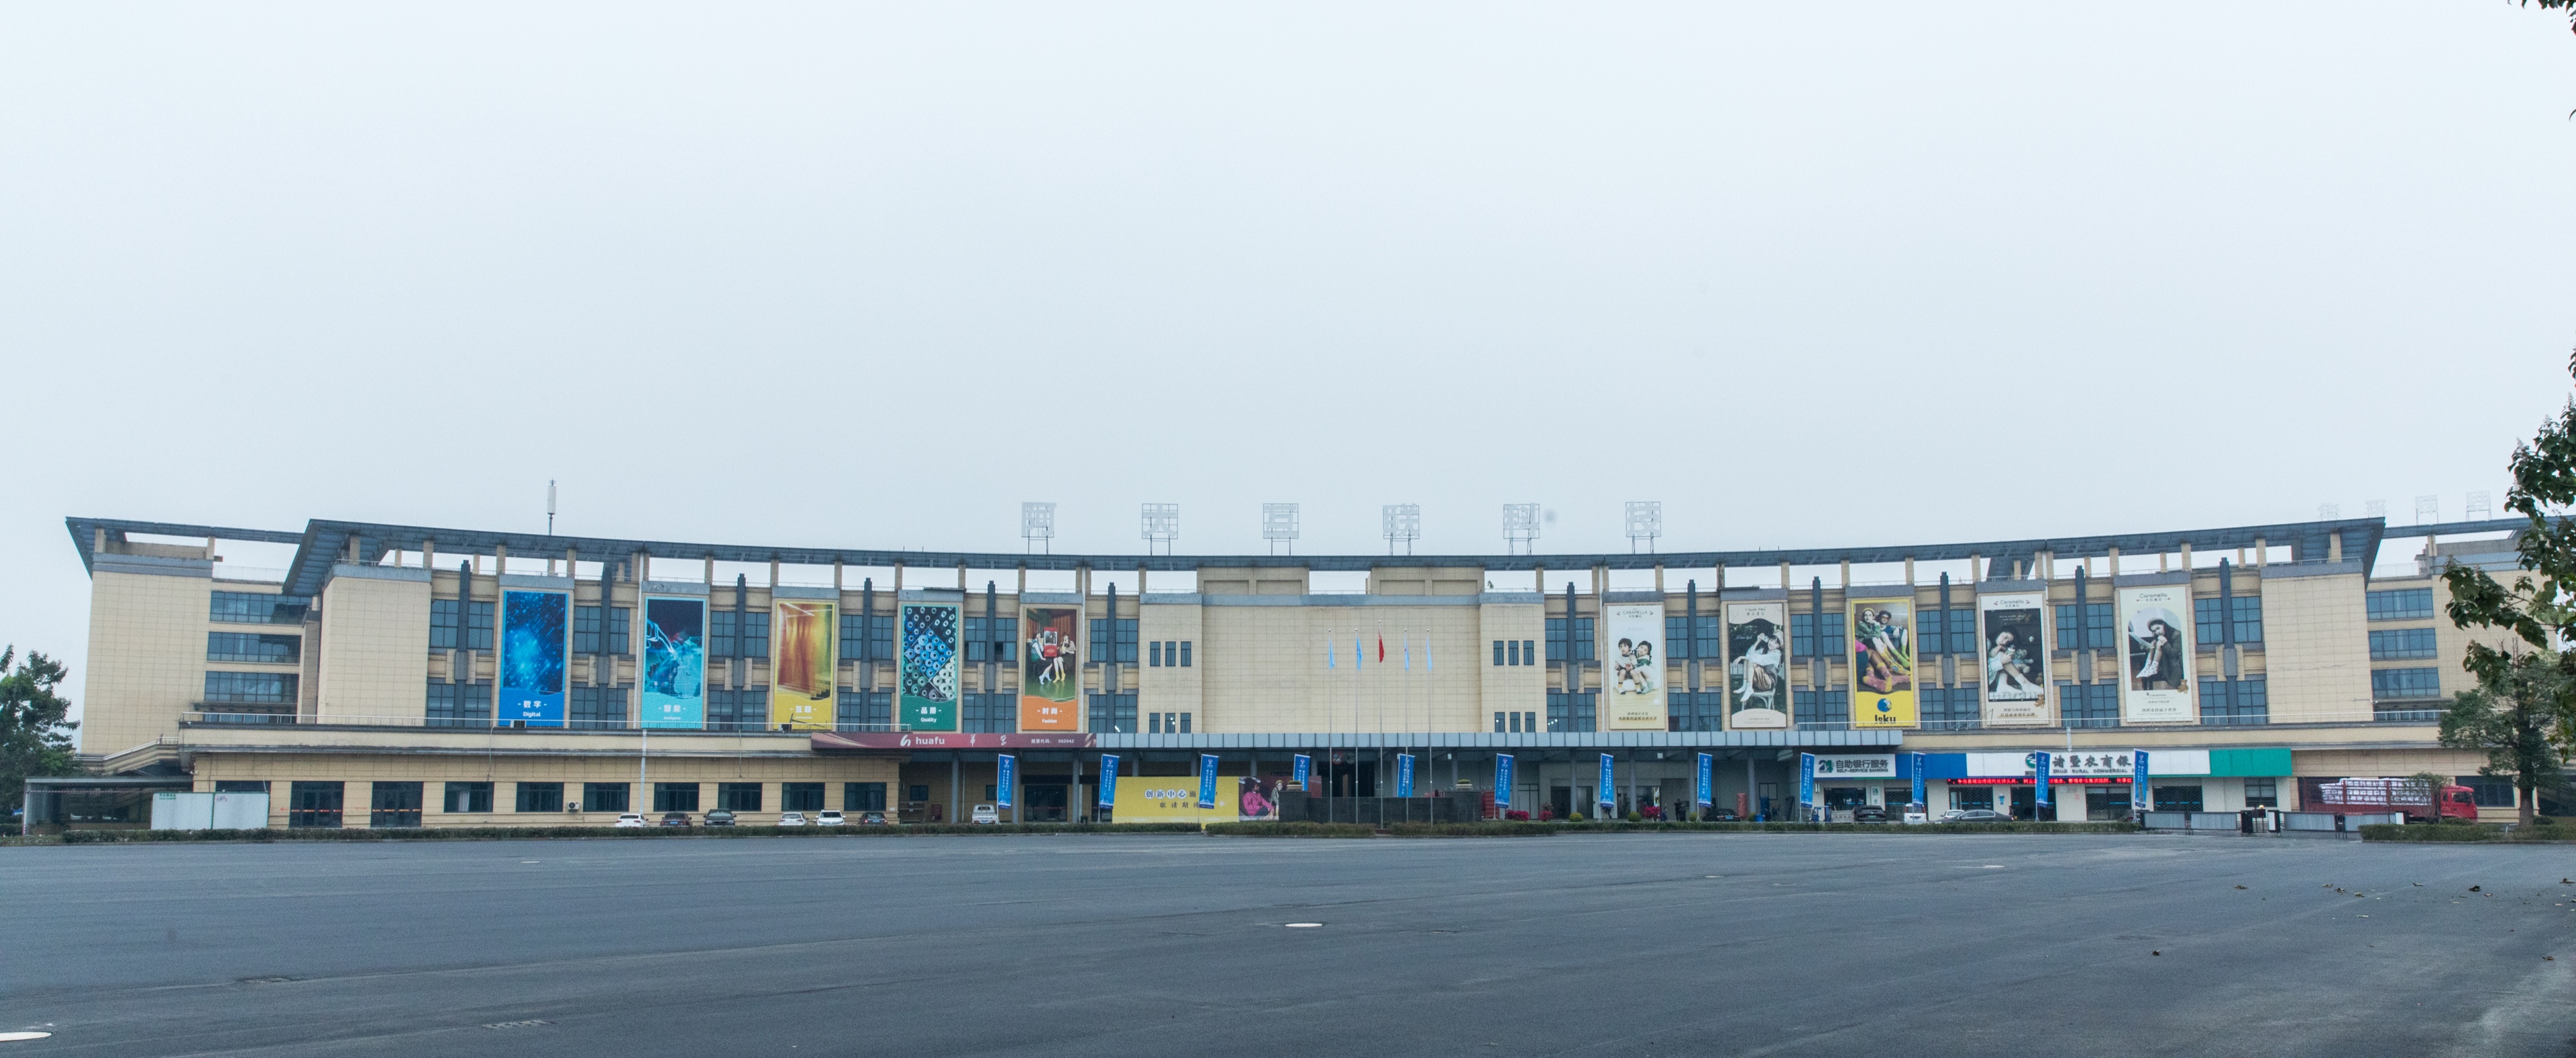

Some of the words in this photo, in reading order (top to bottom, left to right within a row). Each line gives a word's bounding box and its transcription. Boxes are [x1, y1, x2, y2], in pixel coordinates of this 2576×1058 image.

[916, 737, 945, 745] huafu
[1836, 759, 1888, 769] 自助银行服务
